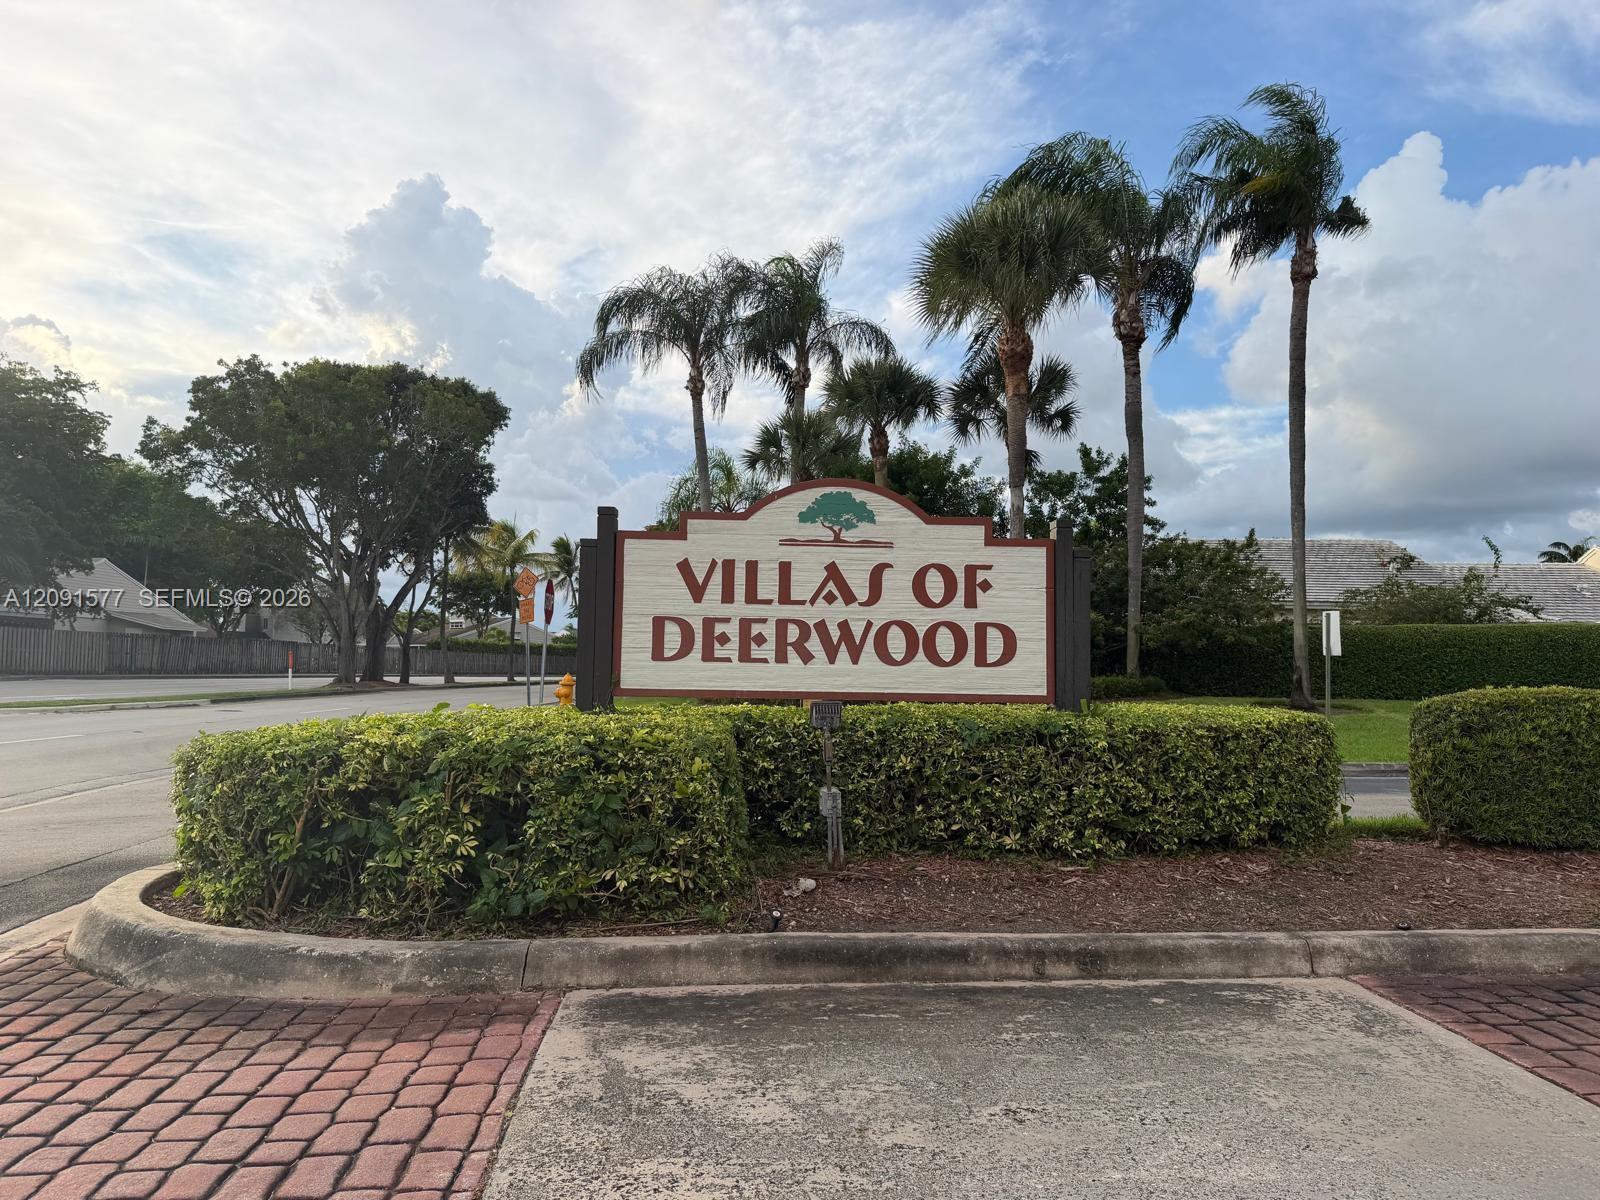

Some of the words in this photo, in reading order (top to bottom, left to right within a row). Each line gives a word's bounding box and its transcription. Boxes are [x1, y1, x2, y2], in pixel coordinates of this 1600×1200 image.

[676, 557, 893, 607] VILLAS
[911, 563, 993, 609] OF
[651, 616, 1017, 667] DEERWOOD
